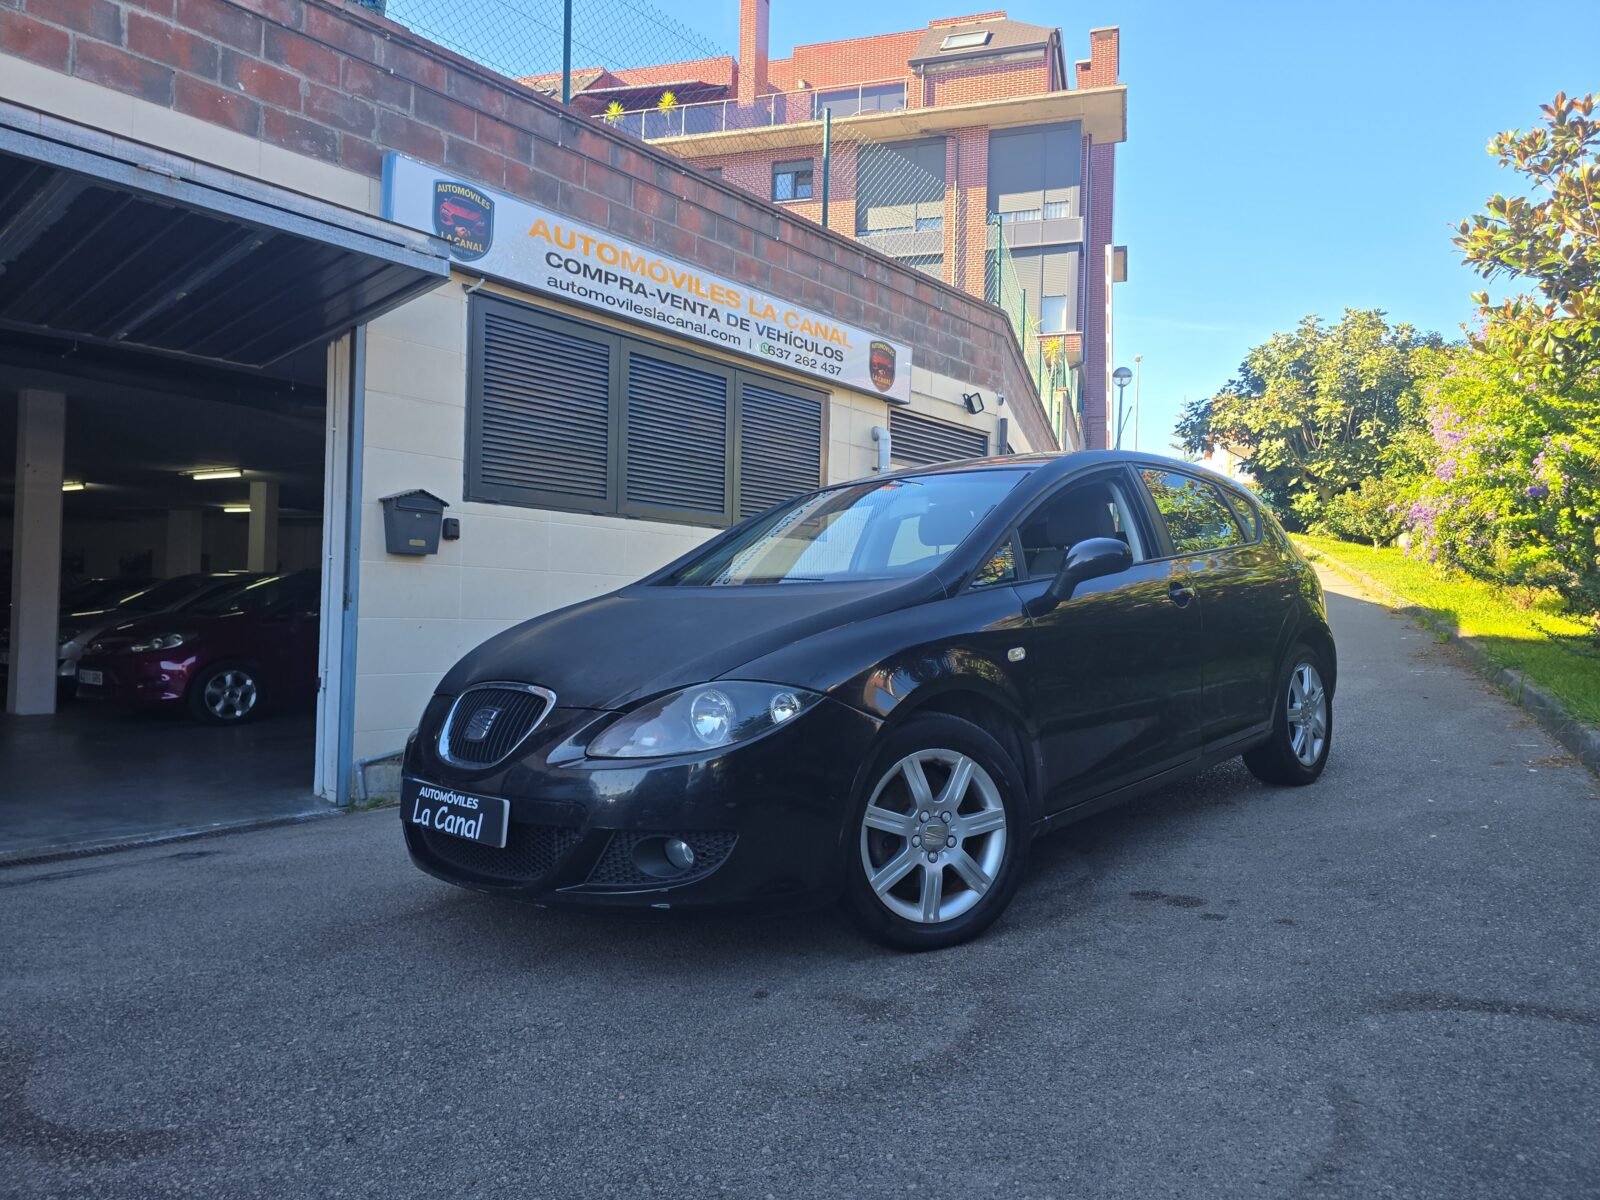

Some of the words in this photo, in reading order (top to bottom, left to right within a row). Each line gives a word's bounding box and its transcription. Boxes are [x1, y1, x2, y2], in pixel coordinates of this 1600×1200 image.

[437, 184, 490, 210] AUTOMÓVILES
[529, 219, 741, 309] AUTOMÓVILES
[748, 297, 777, 322] LA
[783, 311, 853, 349] CANAL
[545, 252, 721, 322] COMPRA-VENTA
[726, 312, 750, 332] DE
[755, 322, 844, 362] VEHÍCULOS
[547, 276, 741, 346] automovileslacanal.com
[767, 345, 791, 360] 637
[794, 354, 817, 368] 262
[820, 362, 842, 376] 437
[412, 798, 431, 827] La
[434, 806, 484, 840] Canal
[419, 786, 479, 810] AUTOMÓVILES
